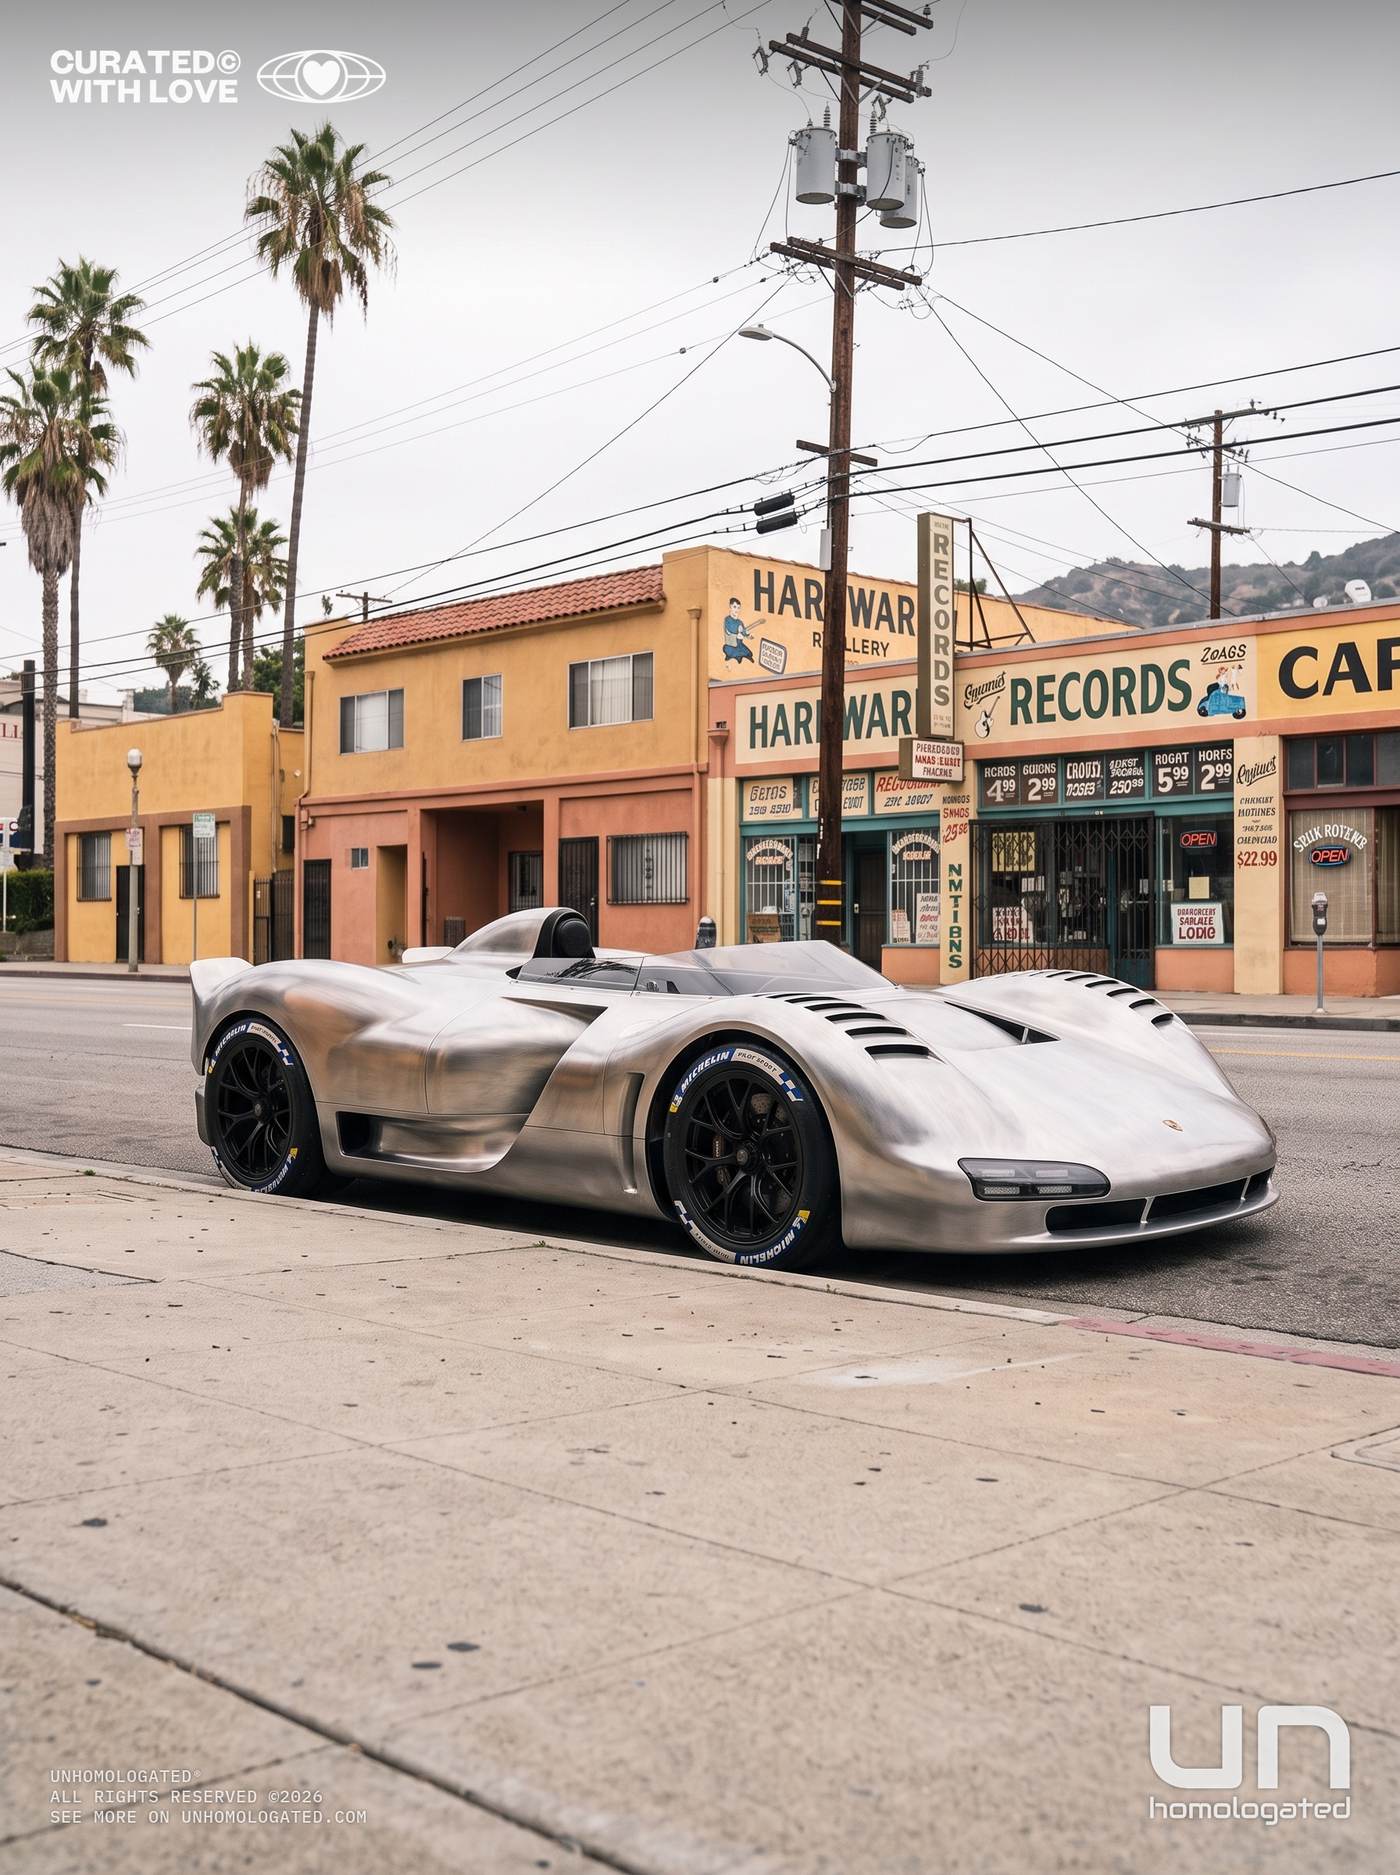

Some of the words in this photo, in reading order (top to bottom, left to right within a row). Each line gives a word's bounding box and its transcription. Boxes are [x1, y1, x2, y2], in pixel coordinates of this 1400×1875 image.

[754, 568, 915, 636] HARWAR
[934, 533, 950, 706] RECORDS
[749, 688, 919, 750] HARWAR
[1009, 658, 1193, 726] RECORDS
[1181, 833, 1217, 846] OPEN
[1237, 850, 1277, 869] $22.99
[1311, 848, 1349, 863] OPEN
